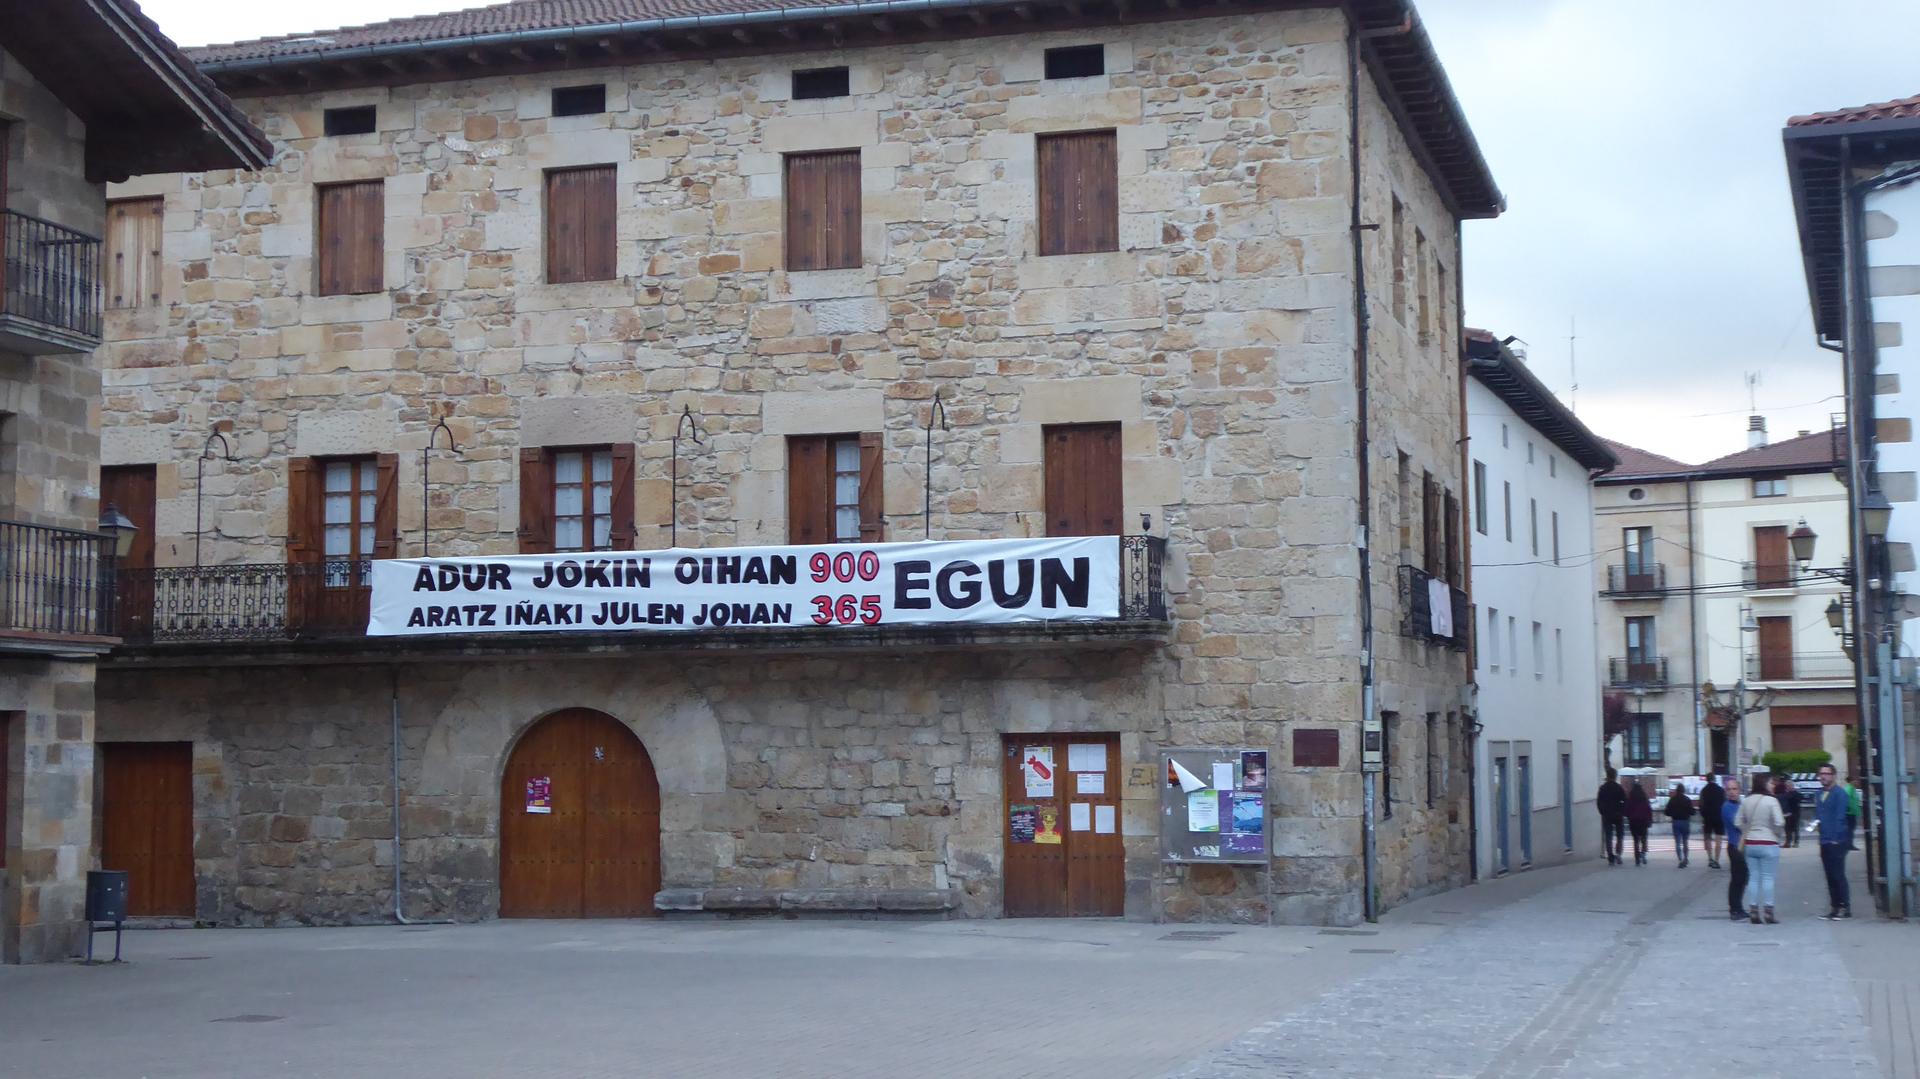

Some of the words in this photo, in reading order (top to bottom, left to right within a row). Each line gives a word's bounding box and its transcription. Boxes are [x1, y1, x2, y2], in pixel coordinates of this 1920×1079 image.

[413, 561, 512, 592] ADUR
[532, 558, 651, 589] JOKIN
[674, 554, 797, 585] OIHAN
[809, 550, 880, 583] 900
[893, 557, 1090, 610] EGUN
[407, 604, 497, 628] ARATZ
[505, 600, 583, 626] IÑAKI
[591, 602, 685, 626] JULEN
[692, 603, 793, 627] JONAN
[810, 595, 881, 625] 365
